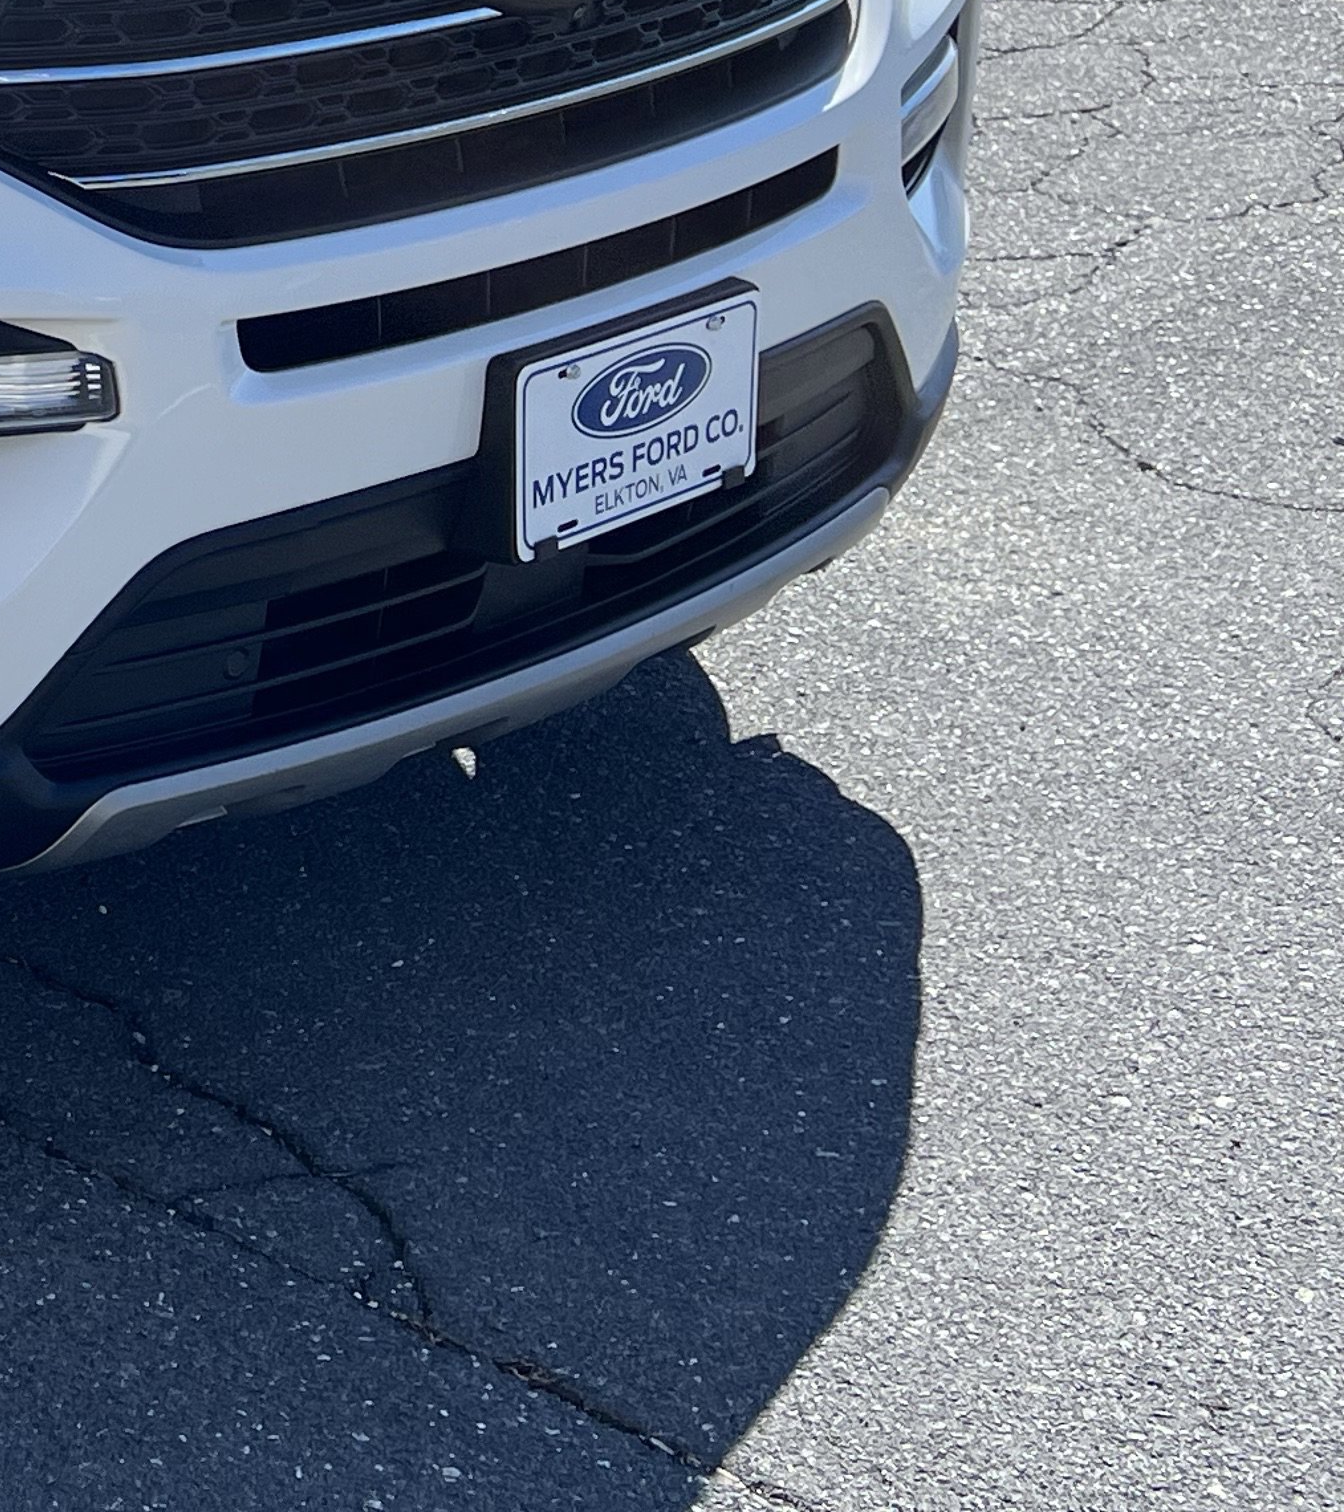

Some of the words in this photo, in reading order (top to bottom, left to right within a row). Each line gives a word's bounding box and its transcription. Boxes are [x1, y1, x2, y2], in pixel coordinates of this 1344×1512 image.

[600, 358, 685, 426] Ford
[532, 451, 625, 509] MYERS
[631, 424, 699, 473] FORD
[705, 408, 744, 443] CO.
[594, 473, 665, 515] ELKTON,
[667, 464, 688, 487] VA
